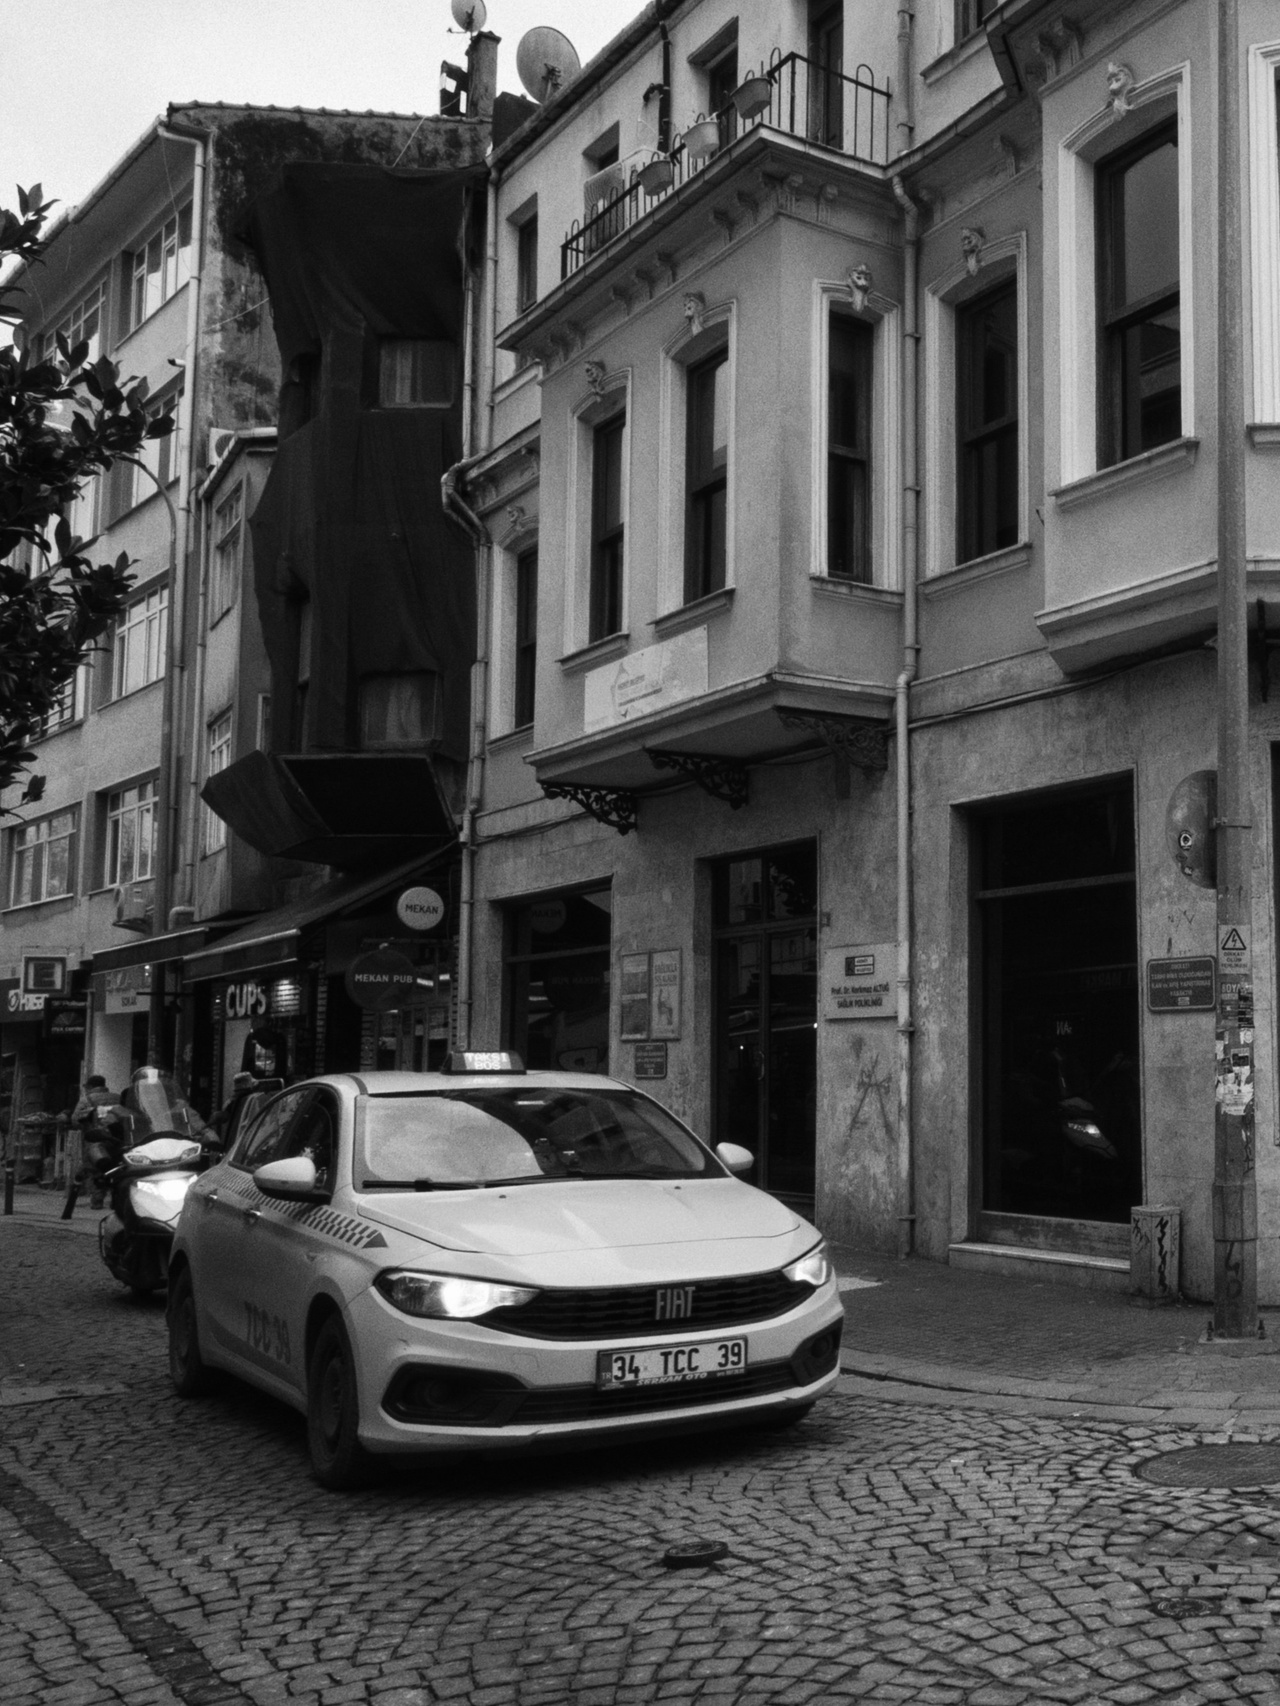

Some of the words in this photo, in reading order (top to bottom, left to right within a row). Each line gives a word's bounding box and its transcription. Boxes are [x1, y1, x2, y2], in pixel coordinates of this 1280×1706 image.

[405, 903, 439, 915] MEKAN
[355, 974, 390, 983] MEKAN
[393, 975, 414, 984] PUB
[225, 983, 267, 1017] CUPS
[655, 1286, 696, 1320] FIAT
[613, 1354, 641, 1381] 34
[660, 1347, 700, 1375] TCC
[717, 1342, 742, 1368] 39
[602, 1371, 612, 1380] TR
[685, 1371, 708, 1381] OTO
